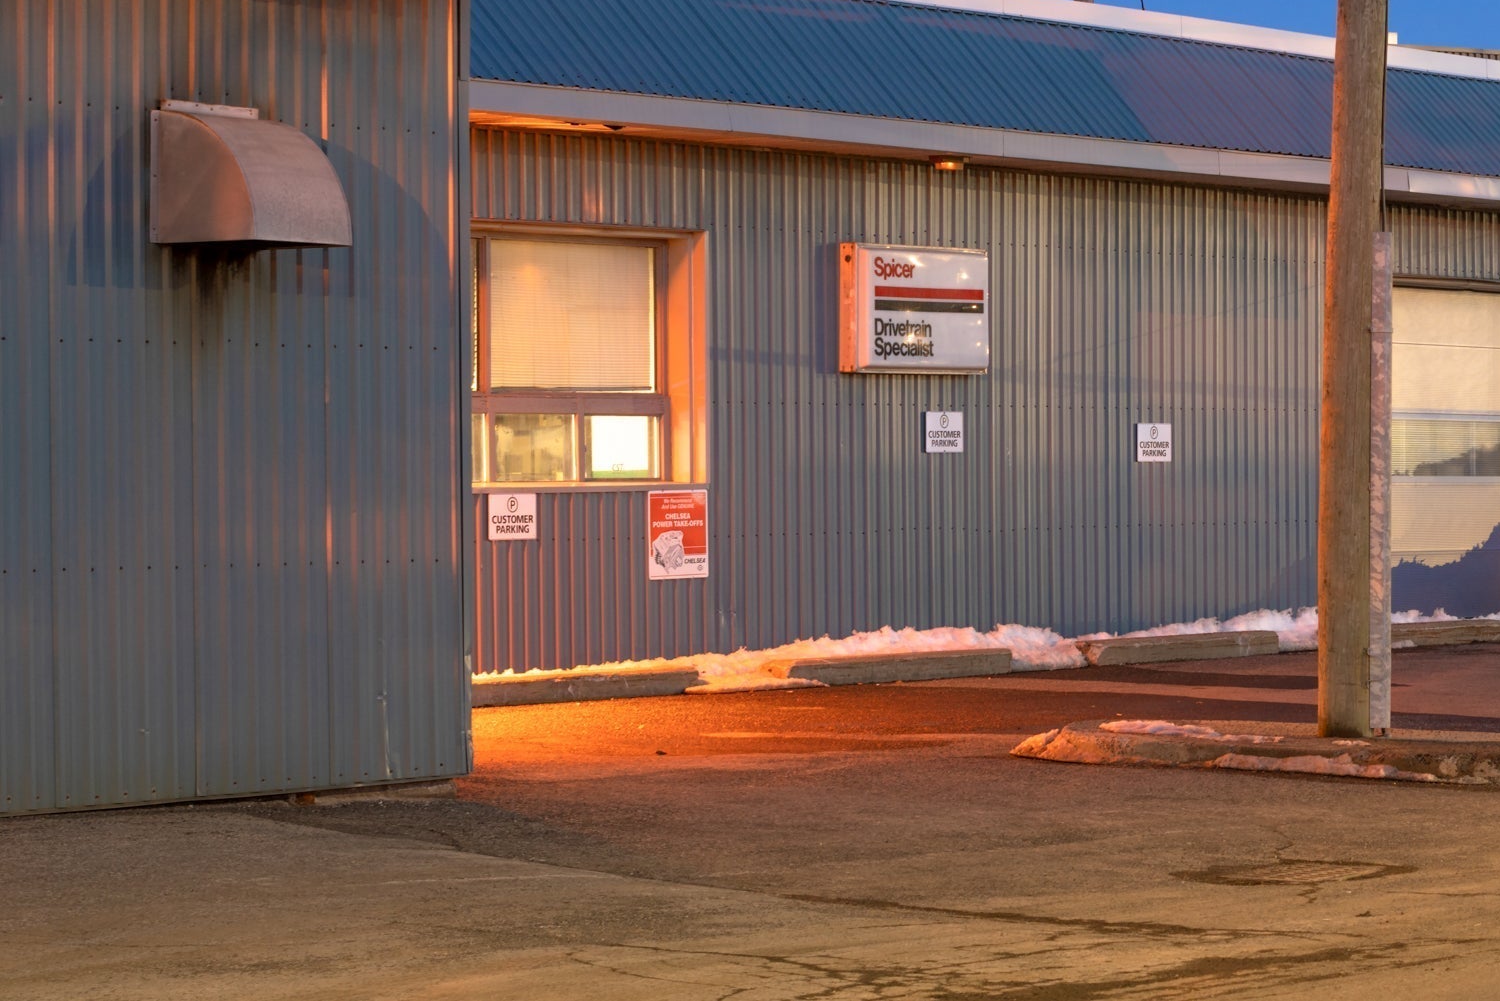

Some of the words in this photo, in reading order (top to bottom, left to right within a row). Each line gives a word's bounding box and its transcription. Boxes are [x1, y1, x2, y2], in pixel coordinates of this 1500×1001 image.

[874, 256, 915, 280] Spicer
[874, 318, 932, 337] Drivetrain
[874, 337, 934, 360] Specialist
[928, 430, 961, 438] CUSTOMER
[931, 439, 958, 447] PARKING
[1139, 441, 1169, 449] CUSTOMER
[1142, 449, 1167, 457] PARKING
[510, 500, 516, 509] P
[491, 515, 534, 524] CUSTOMER
[665, 512, 691, 520] CHELSEA
[652, 520, 673, 528] POWER
[496, 525, 530, 534] PARKING
